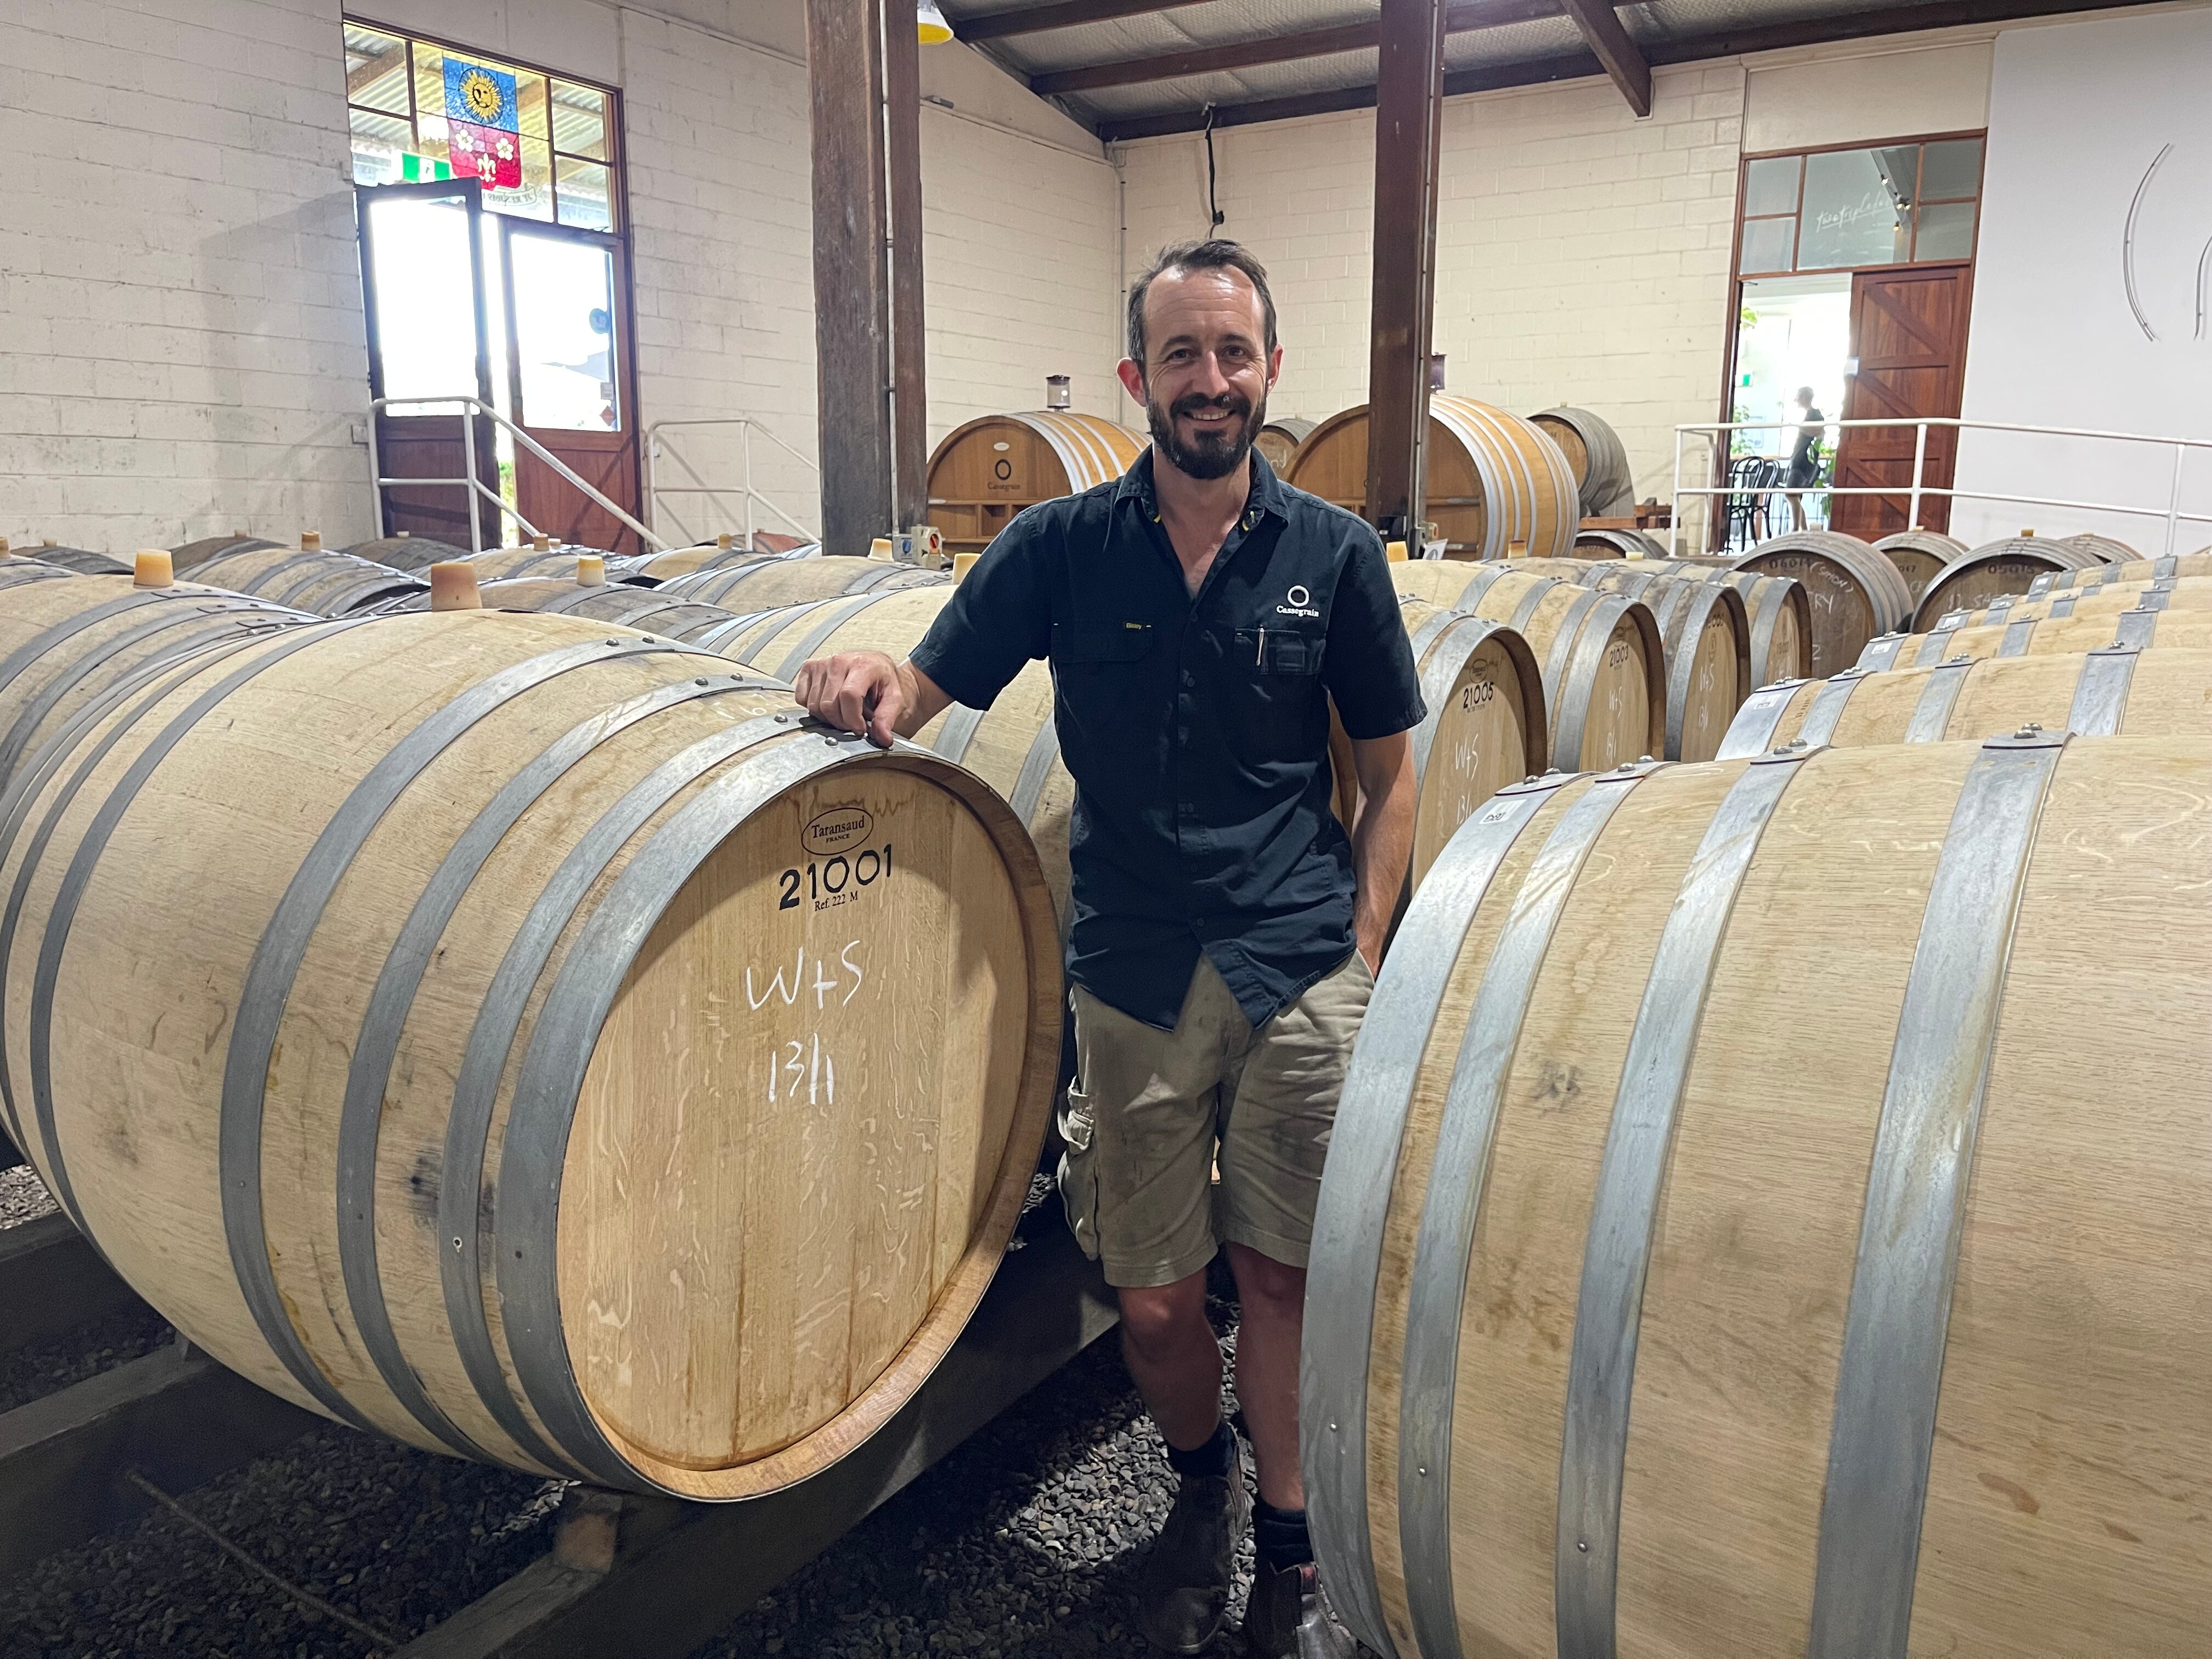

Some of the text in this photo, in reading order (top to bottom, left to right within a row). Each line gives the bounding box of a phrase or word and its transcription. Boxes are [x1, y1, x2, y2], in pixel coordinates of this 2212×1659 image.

[1276, 605, 1319, 617] Cassegrain
[1610, 644, 1628, 667] 21003
[1463, 681, 1494, 709] 21005
[1455, 733, 1479, 781] W+S
[811, 815, 865, 838] Taransaud
[826, 833, 850, 843] FRANCE
[779, 843, 891, 911] 21001
[815, 890, 858, 911] Ref. 222 M
